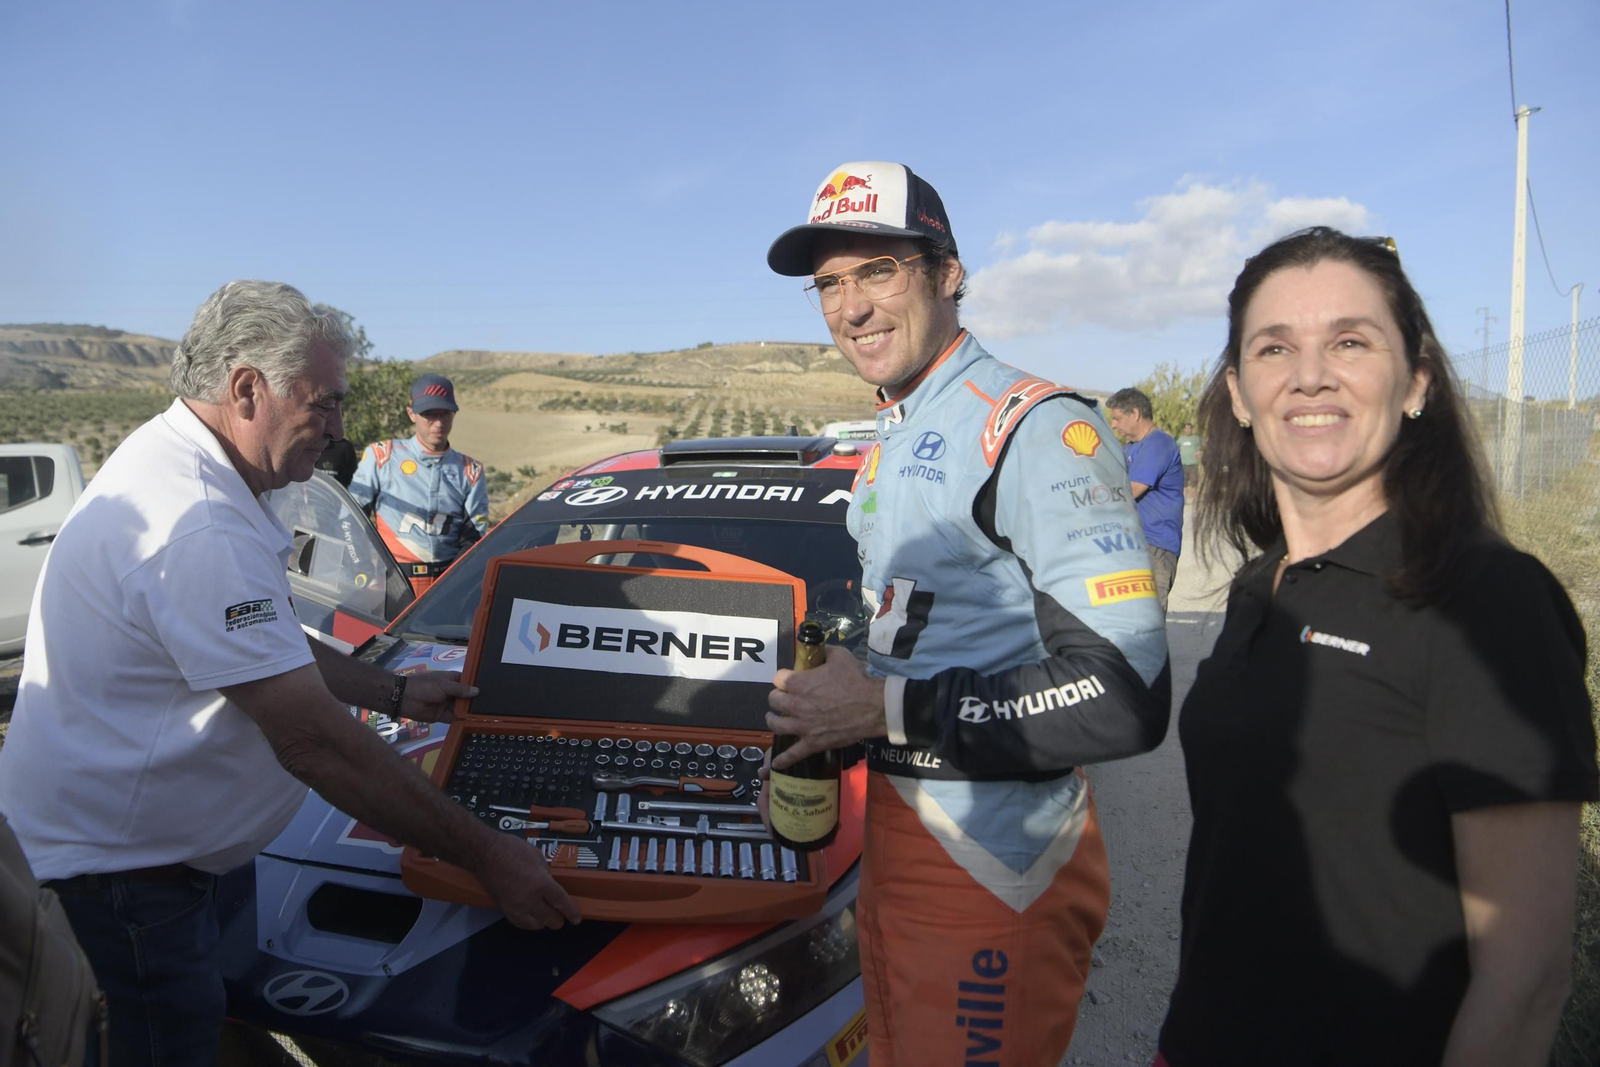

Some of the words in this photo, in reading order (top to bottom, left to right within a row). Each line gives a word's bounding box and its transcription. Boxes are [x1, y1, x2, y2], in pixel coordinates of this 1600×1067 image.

[836, 194, 878, 215] Bull
[634, 484, 804, 502] HYUNDAI
[1066, 522, 1123, 541] HYUNDAI
[557, 623, 766, 664] BERNER
[1311, 631, 1371, 656] BERNER
[993, 675, 1105, 720] HYUNDAI
[881, 748, 942, 769] NEUVILLE
[955, 948, 1009, 1067] ville
